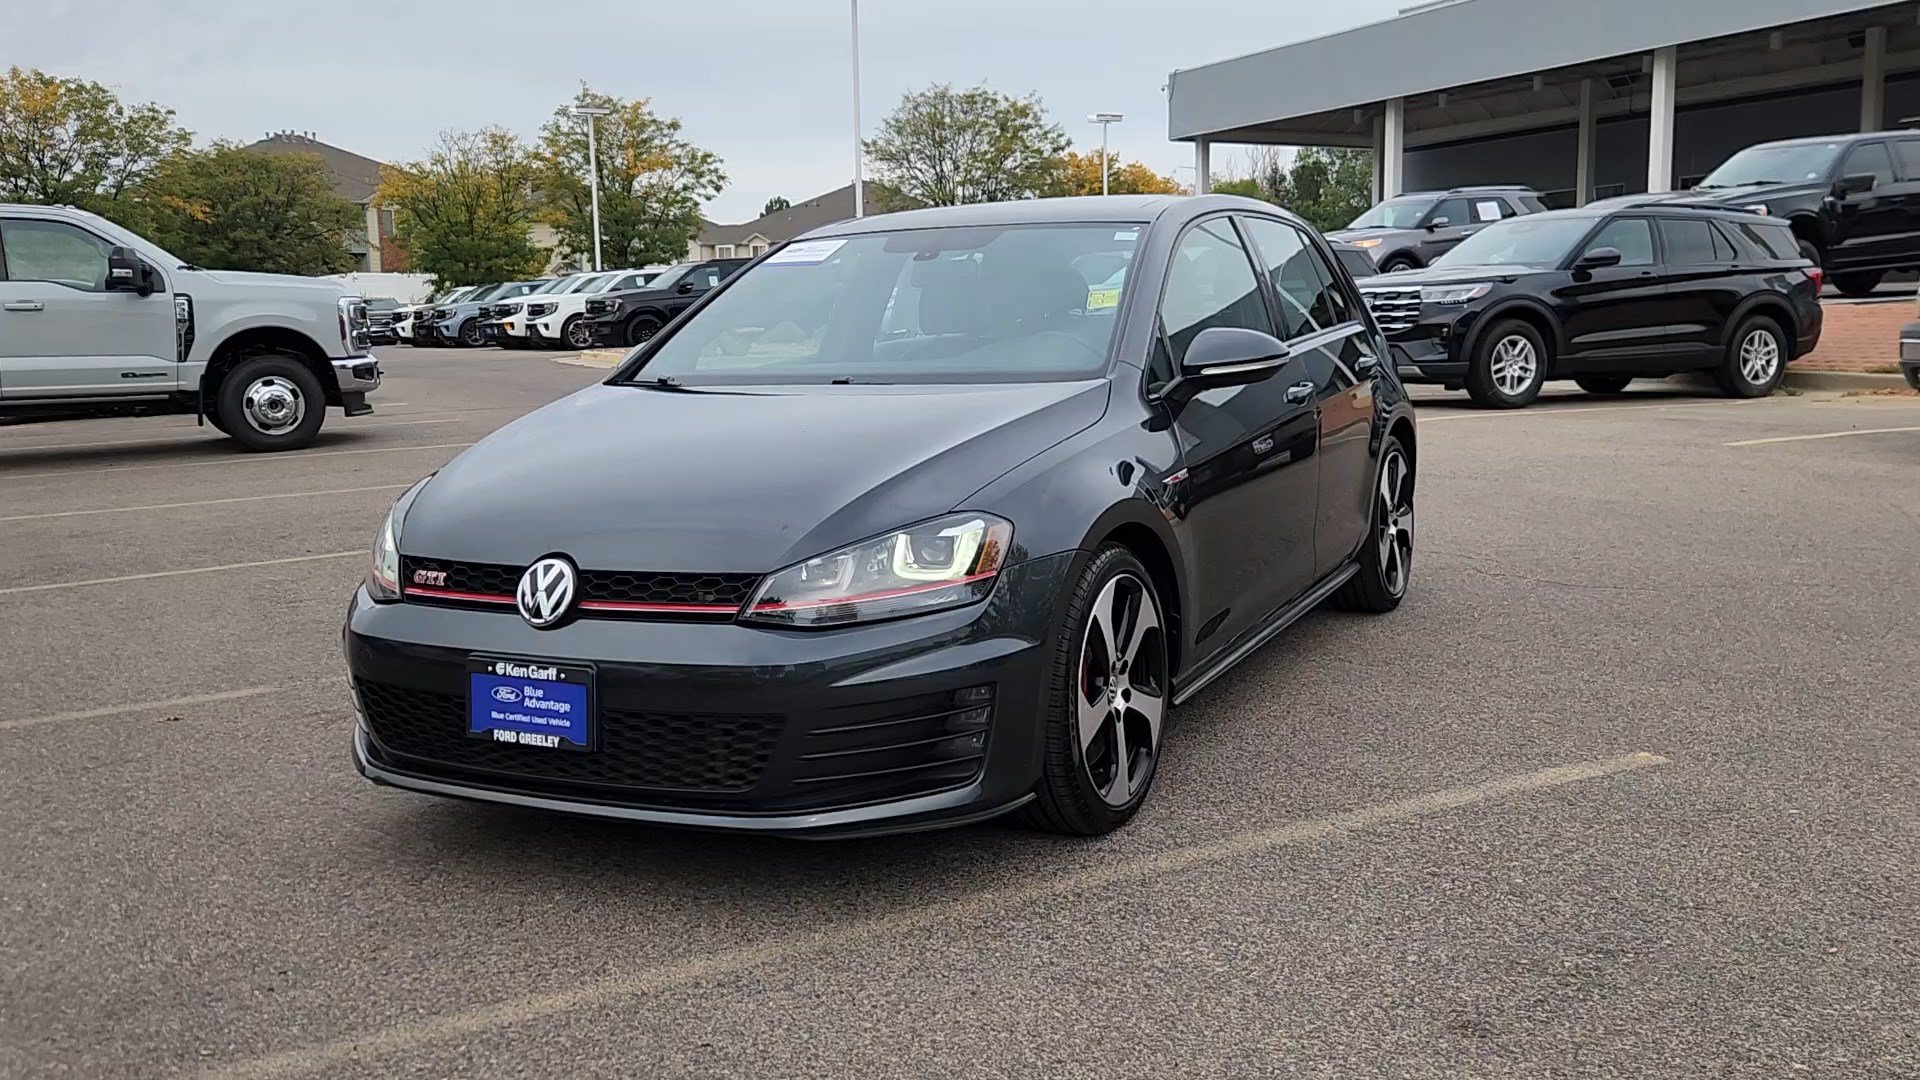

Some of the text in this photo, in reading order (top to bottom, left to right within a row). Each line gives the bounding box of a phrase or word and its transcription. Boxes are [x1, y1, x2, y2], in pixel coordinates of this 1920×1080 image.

[413, 569, 447, 585] GTI
[505, 662, 557, 680] Ken Garff
[523, 685, 544, 698] Blue
[523, 697, 571, 713] Advantage
[491, 711, 570, 727] Blue Certified Used Vehicle
[493, 729, 560, 748] FORD GREELEY
